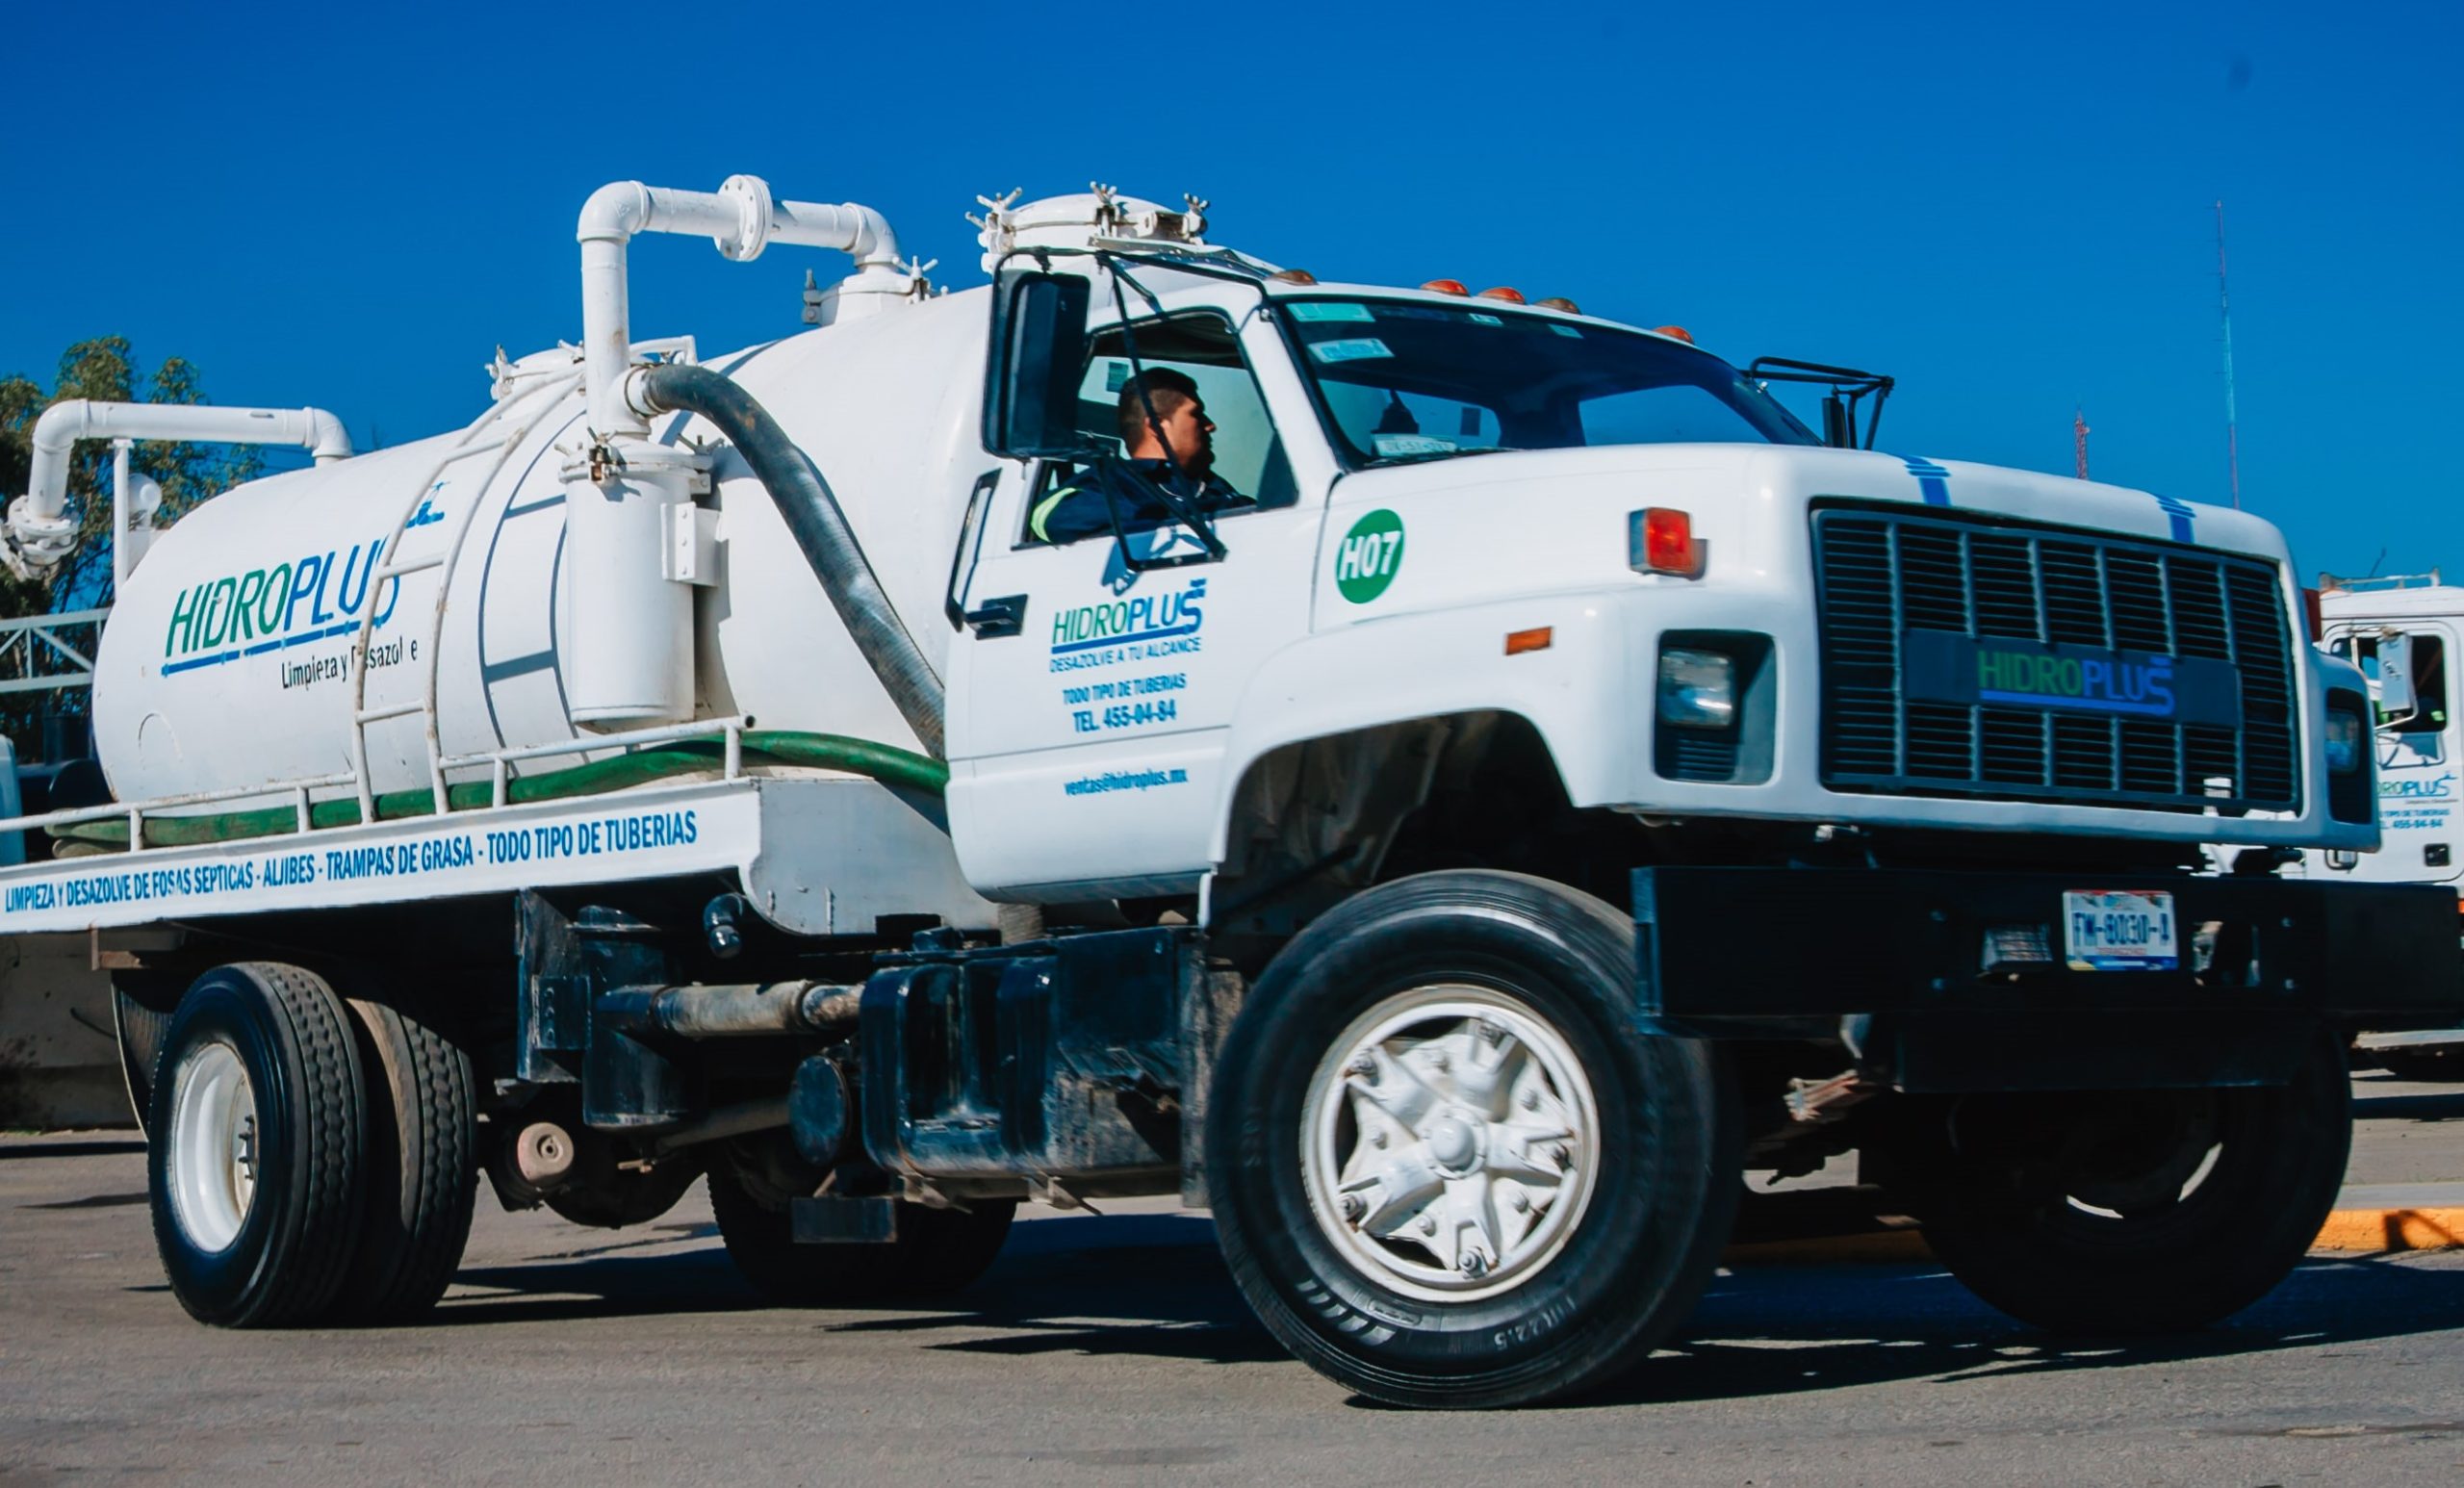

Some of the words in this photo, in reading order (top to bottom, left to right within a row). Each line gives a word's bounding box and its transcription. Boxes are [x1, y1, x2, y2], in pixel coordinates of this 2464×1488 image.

[1052, 577, 1207, 646] HIDROPLUS
[281, 655, 338, 691] Limpieza
[341, 654, 348, 683] y
[351, 635, 418, 672] sazole
[1049, 650, 1115, 673] DESAZOLVE
[1116, 649, 1125, 662] A
[1128, 645, 1143, 660] TU
[1146, 636, 1202, 657] ALCANCE
[1063, 686, 1091, 705] TODO
[1092, 681, 1115, 701] TIPO
[1117, 680, 1132, 697] DE
[1133, 672, 1186, 695] TUBERIAS
[1977, 650, 2175, 716] HIDROPLUS
[1103, 698, 1176, 729] 455-04-84
[6, 883, 56, 913] LIMPIEZA
[58, 882, 64, 908] Y
[66, 873, 133, 908] DESAZOLVE
[134, 871, 151, 901] DE
[152, 867, 192, 899] FOSAS
[194, 860, 254, 894] SEPTICAS
[263, 854, 316, 887] ALJIBES
[326, 845, 395, 882] TRAMPAS
[398, 842, 418, 875] DE
[421, 834, 475, 872] GRASA
[486, 829, 530, 864] TODO
[534, 825, 574, 859] TIPO
[578, 821, 602, 856] DE
[604, 809, 697, 853] TUBERIAS
